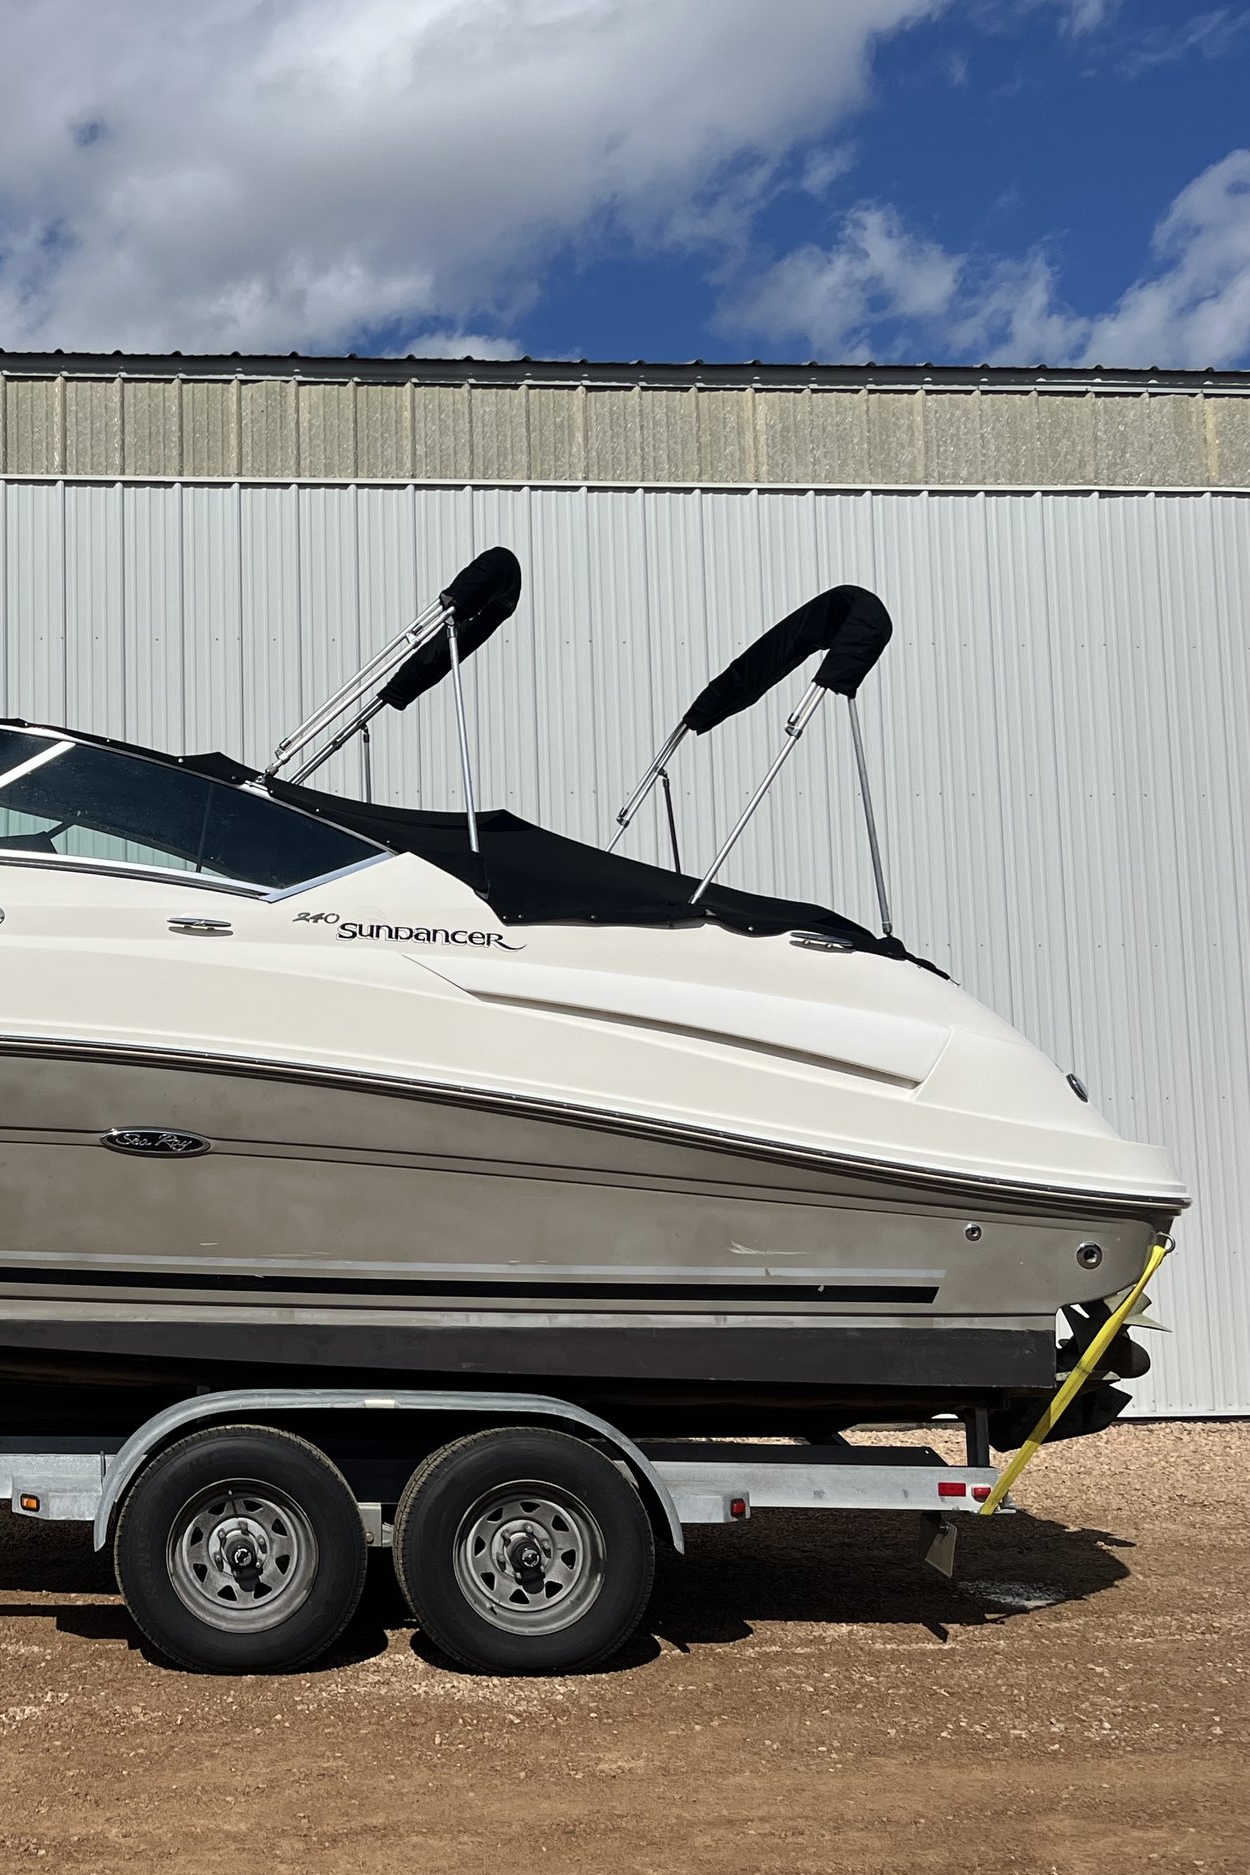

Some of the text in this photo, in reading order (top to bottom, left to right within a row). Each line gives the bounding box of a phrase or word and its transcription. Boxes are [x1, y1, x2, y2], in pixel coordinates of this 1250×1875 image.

[292, 912, 340, 925] 240
[115, 1132, 193, 1152] Sea Ray
